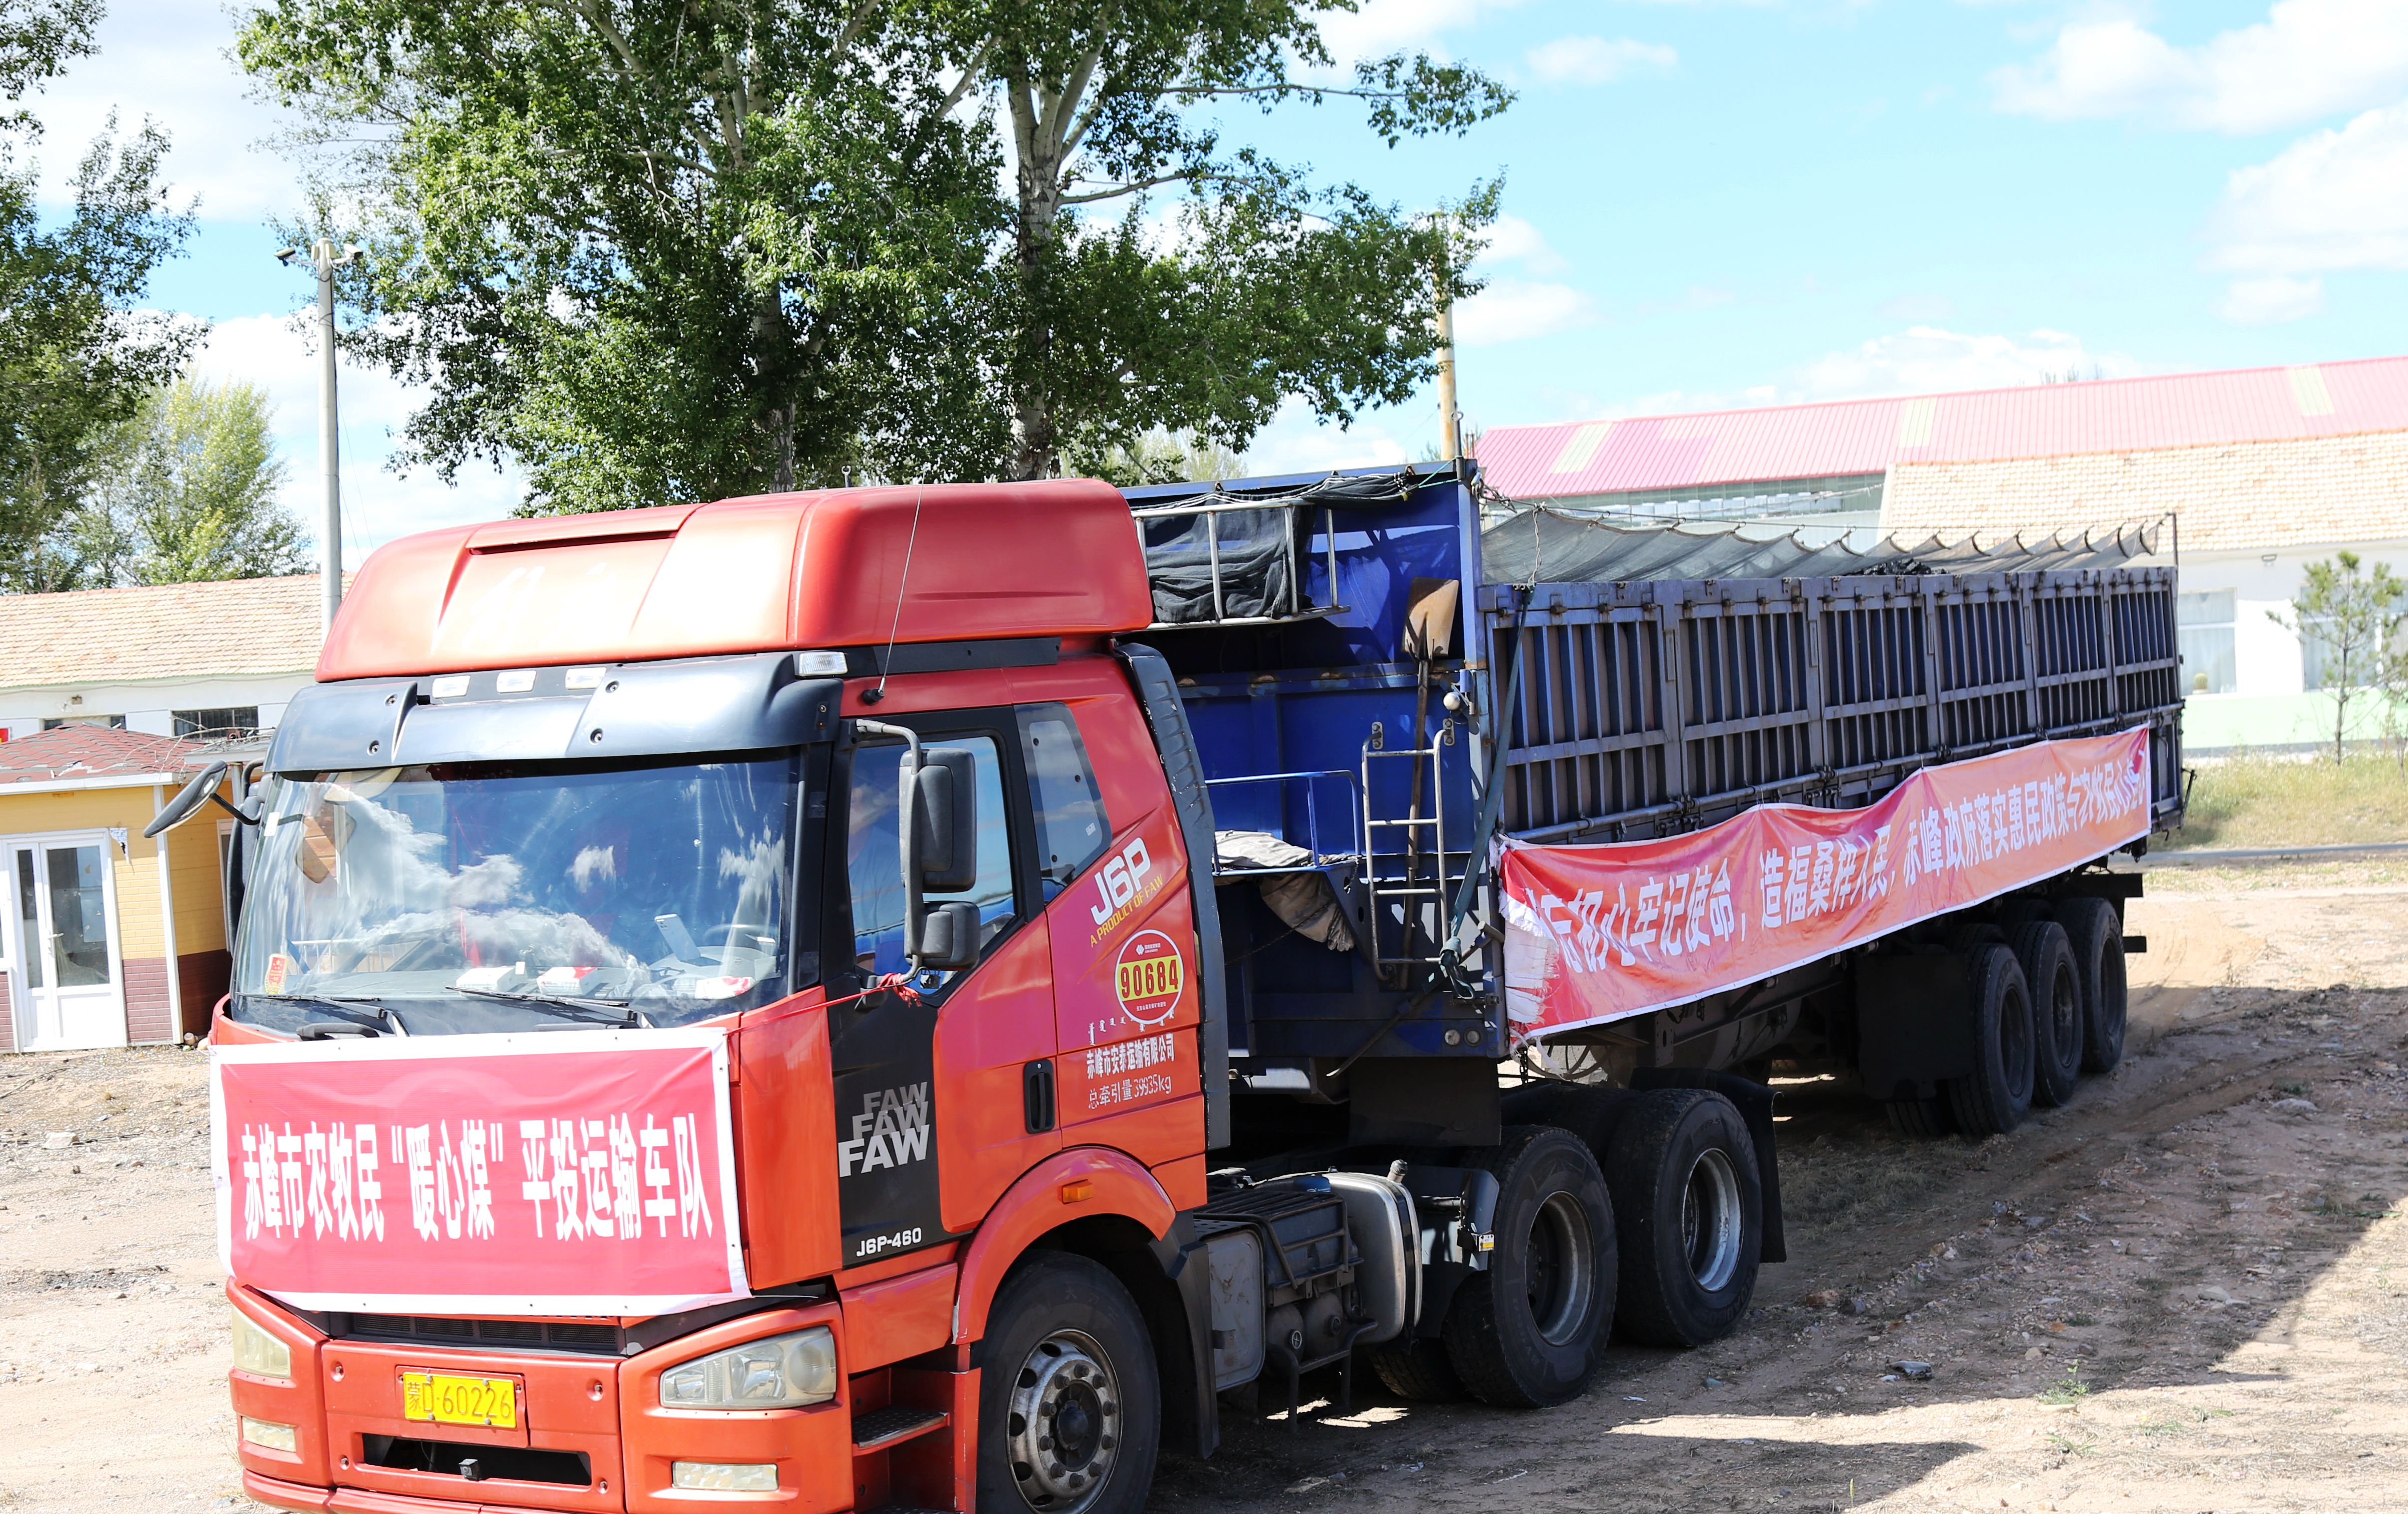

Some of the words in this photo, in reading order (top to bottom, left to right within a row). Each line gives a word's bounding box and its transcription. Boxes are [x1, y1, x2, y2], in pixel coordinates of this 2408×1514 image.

[1090, 837, 1151, 925] J6P
[1090, 934, 1098, 948] A
[1097, 902, 1134, 940] PRODUCT
[1133, 893, 1144, 908] OF
[1144, 874, 1164, 898] FAW
[1121, 959, 1178, 999] 90684
[1086, 1032, 1174, 1080] 赤峰市安泰运输有限公司
[863, 1082, 928, 1114] FAW
[852, 1101, 929, 1140] FAW
[838, 1124, 930, 1177] FAW
[856, 1227, 922, 1257] J6P-460
